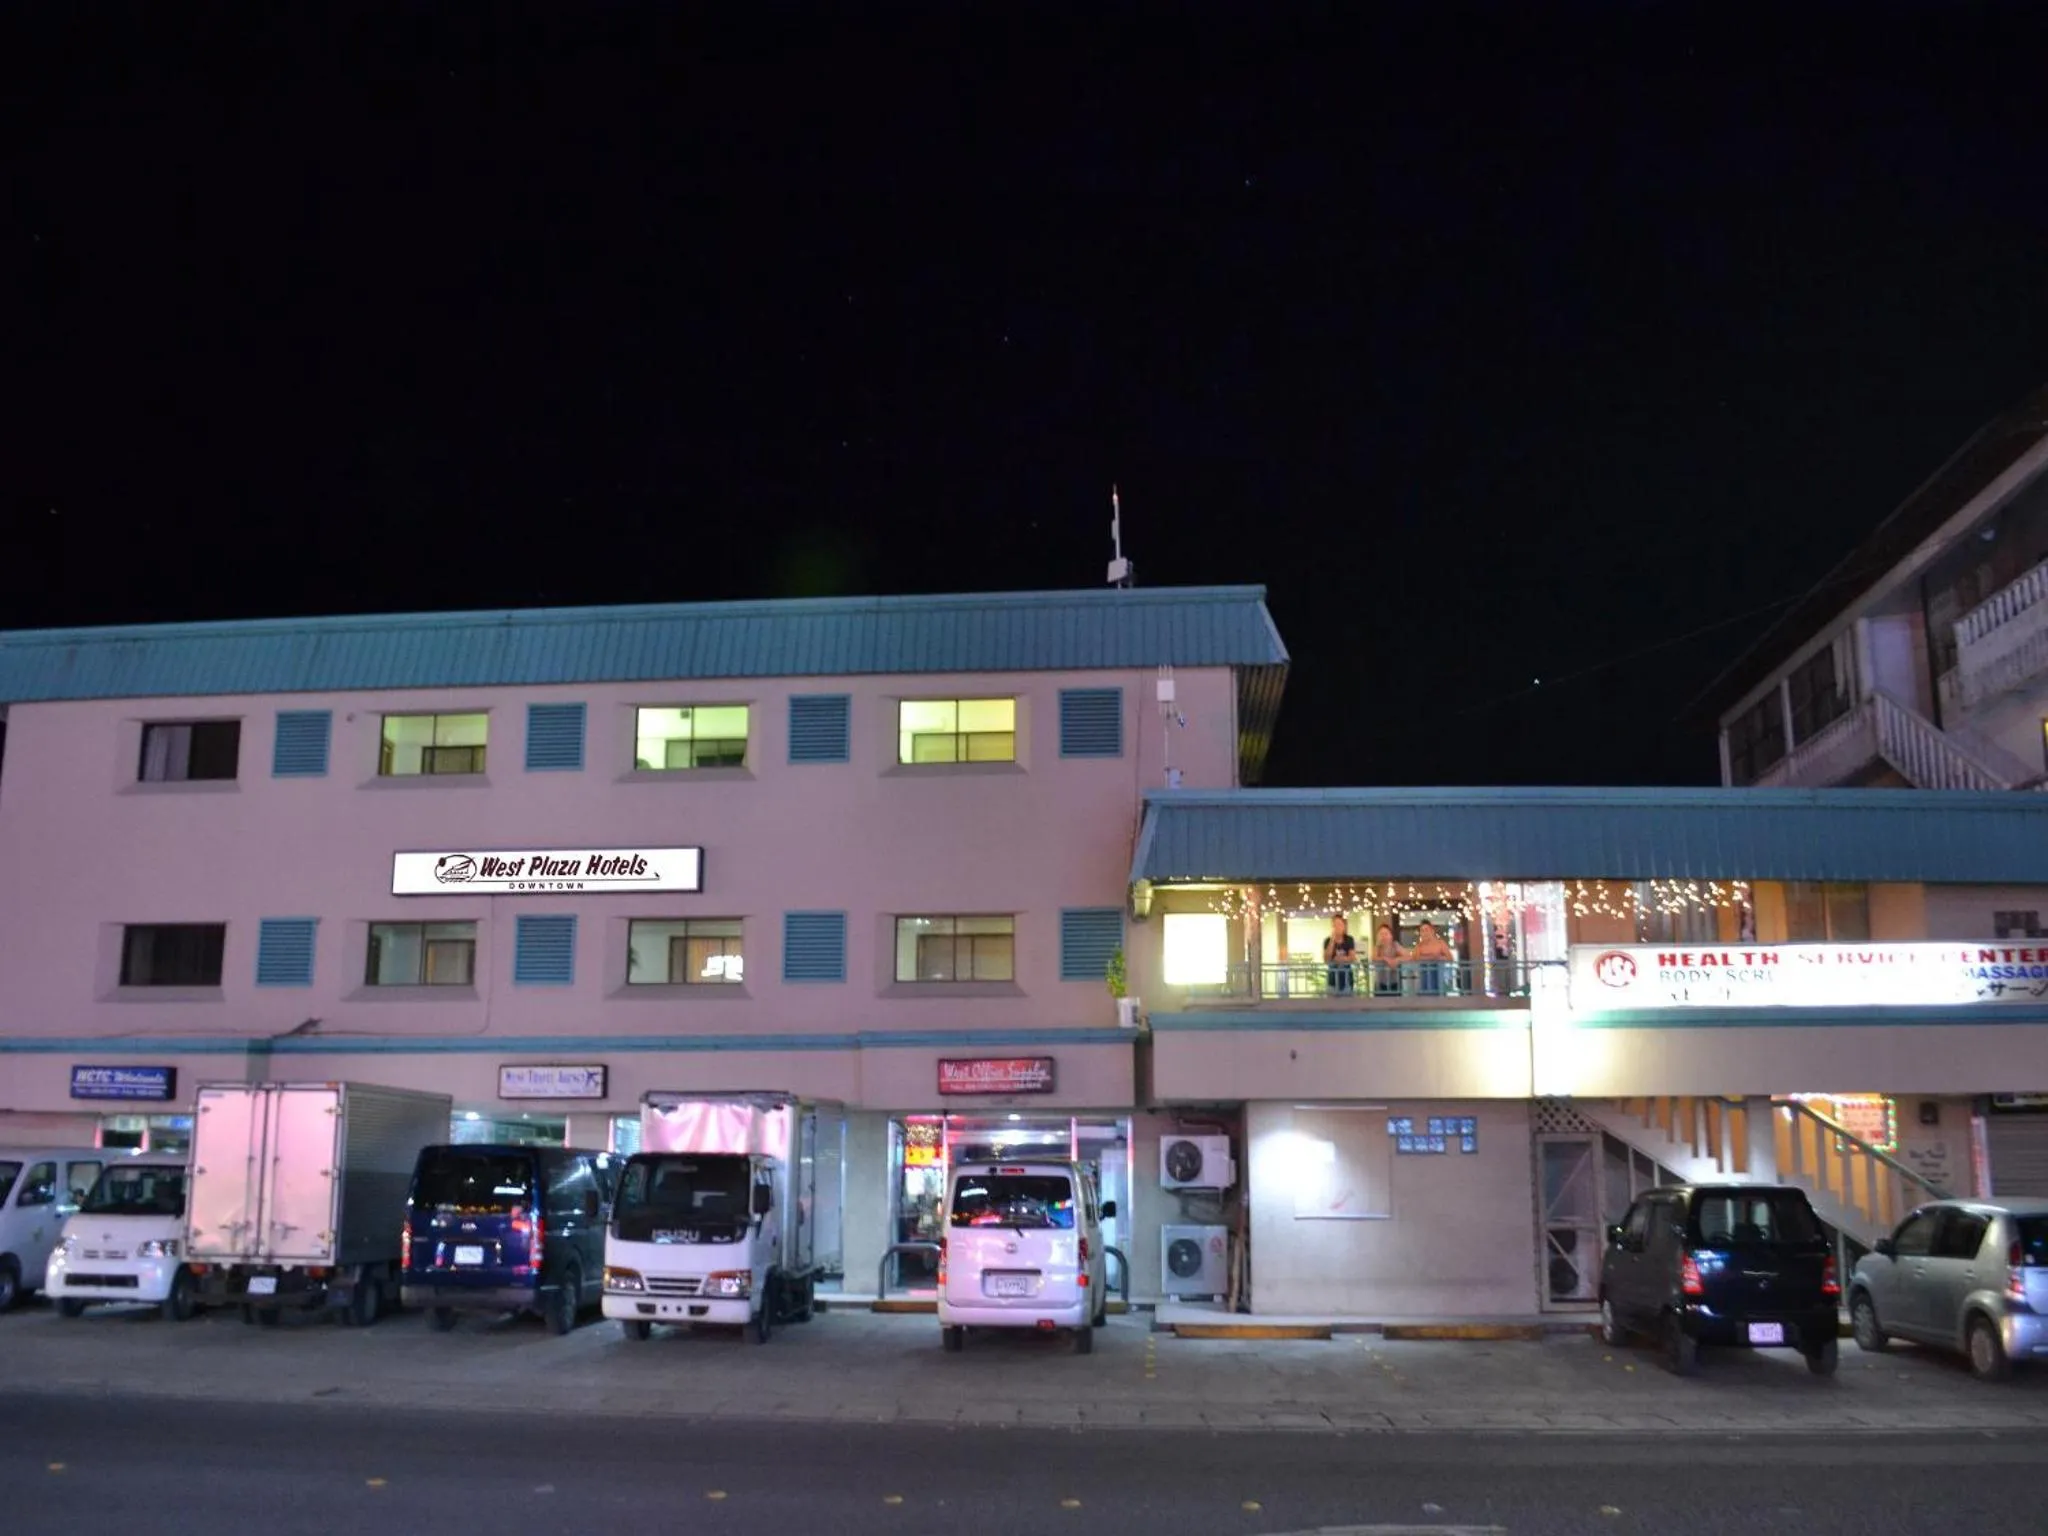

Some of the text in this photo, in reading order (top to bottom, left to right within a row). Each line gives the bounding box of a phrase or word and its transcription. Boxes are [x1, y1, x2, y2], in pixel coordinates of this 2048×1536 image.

[480, 853, 649, 877] West Plaza Hotels
[509, 882, 584, 890] DOWNTOWN
[1657, 952, 1779, 967] HEALTH
[1963, 965, 2048, 979] ASSAG
